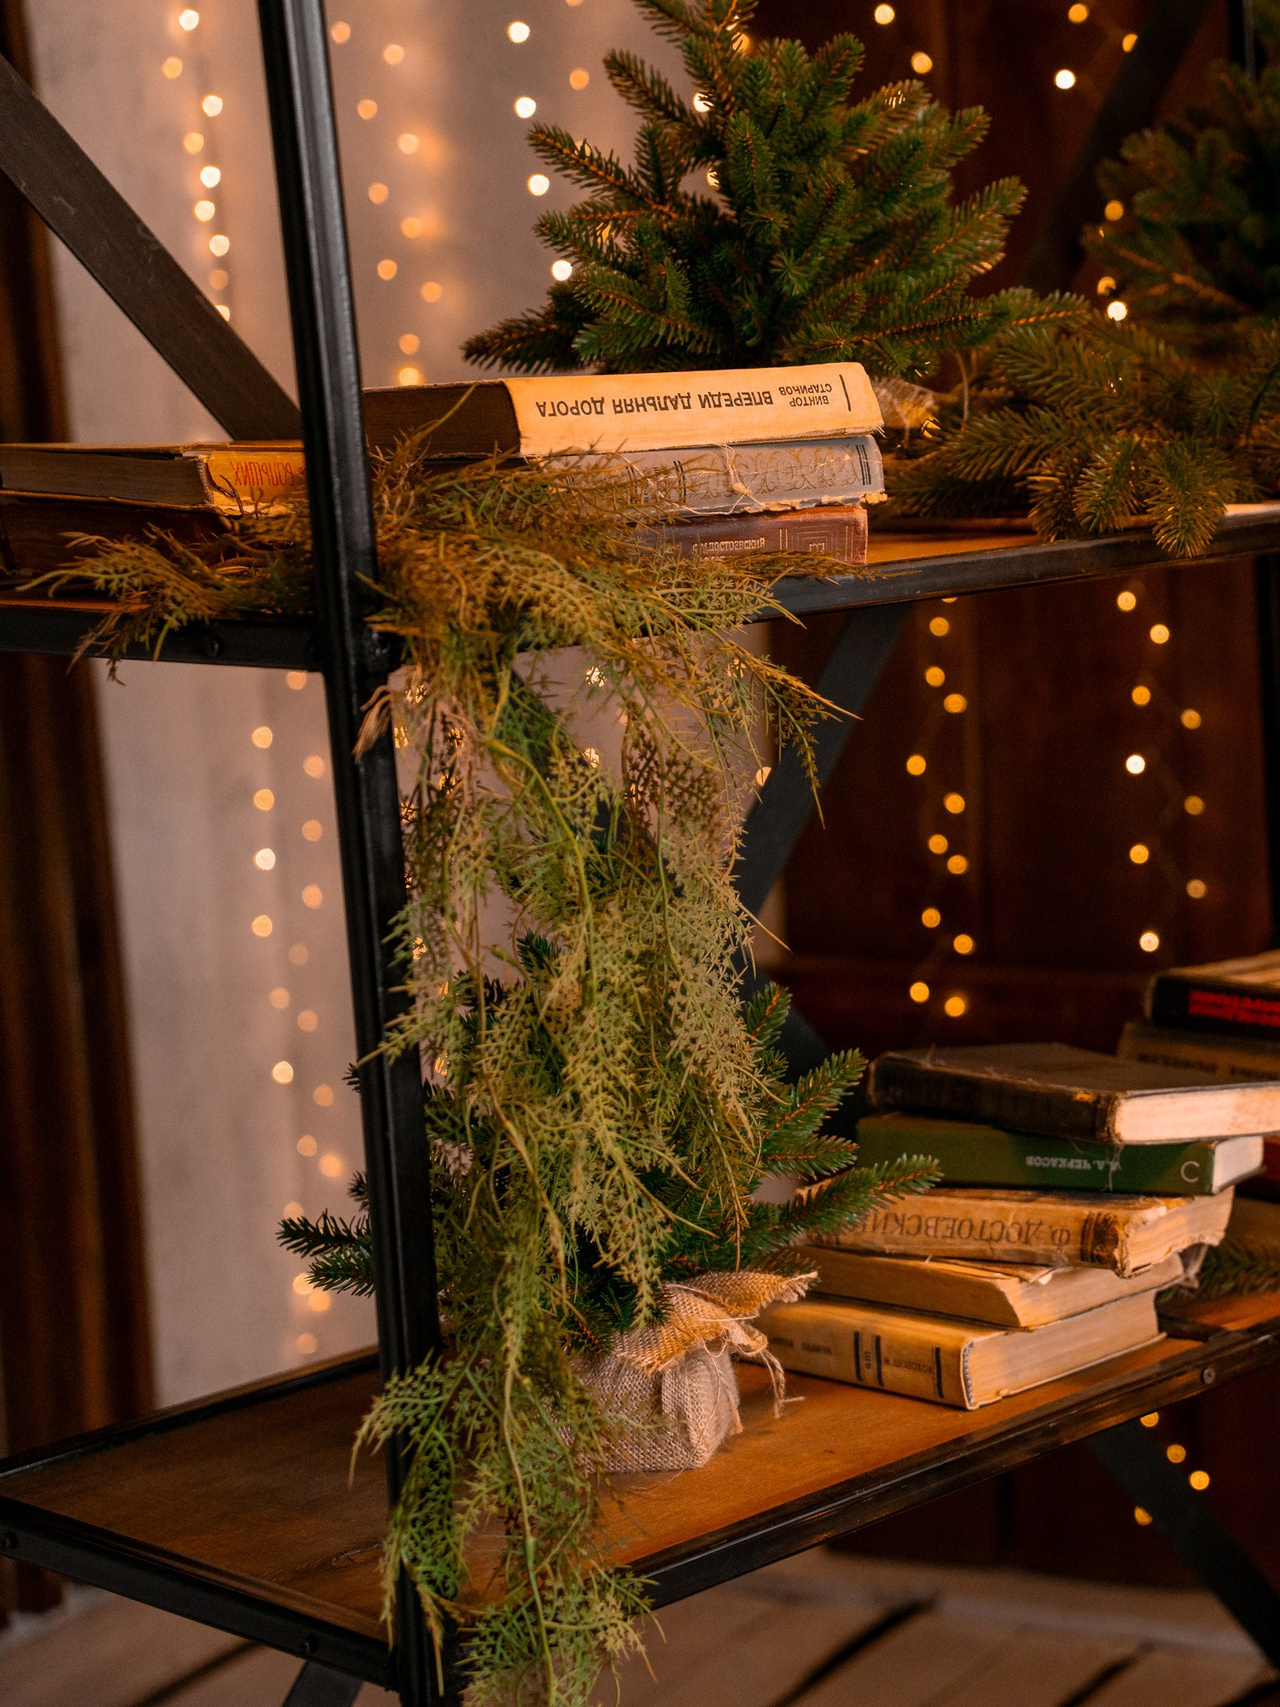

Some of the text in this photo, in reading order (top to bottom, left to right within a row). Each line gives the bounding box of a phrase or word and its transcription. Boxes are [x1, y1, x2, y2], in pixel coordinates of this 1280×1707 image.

[778, 383, 832, 396] СТАРИКОВ
[535, 390, 774, 417] ВПЕРЕДИ ДАЛЬНЯЯ ДОРОГА
[789, 395, 829, 408] ВИКТОР
[230, 461, 295, 486] БОЛЬШИХ
[1025, 1155, 1092, 1171] ЧЕРКАСОВ
